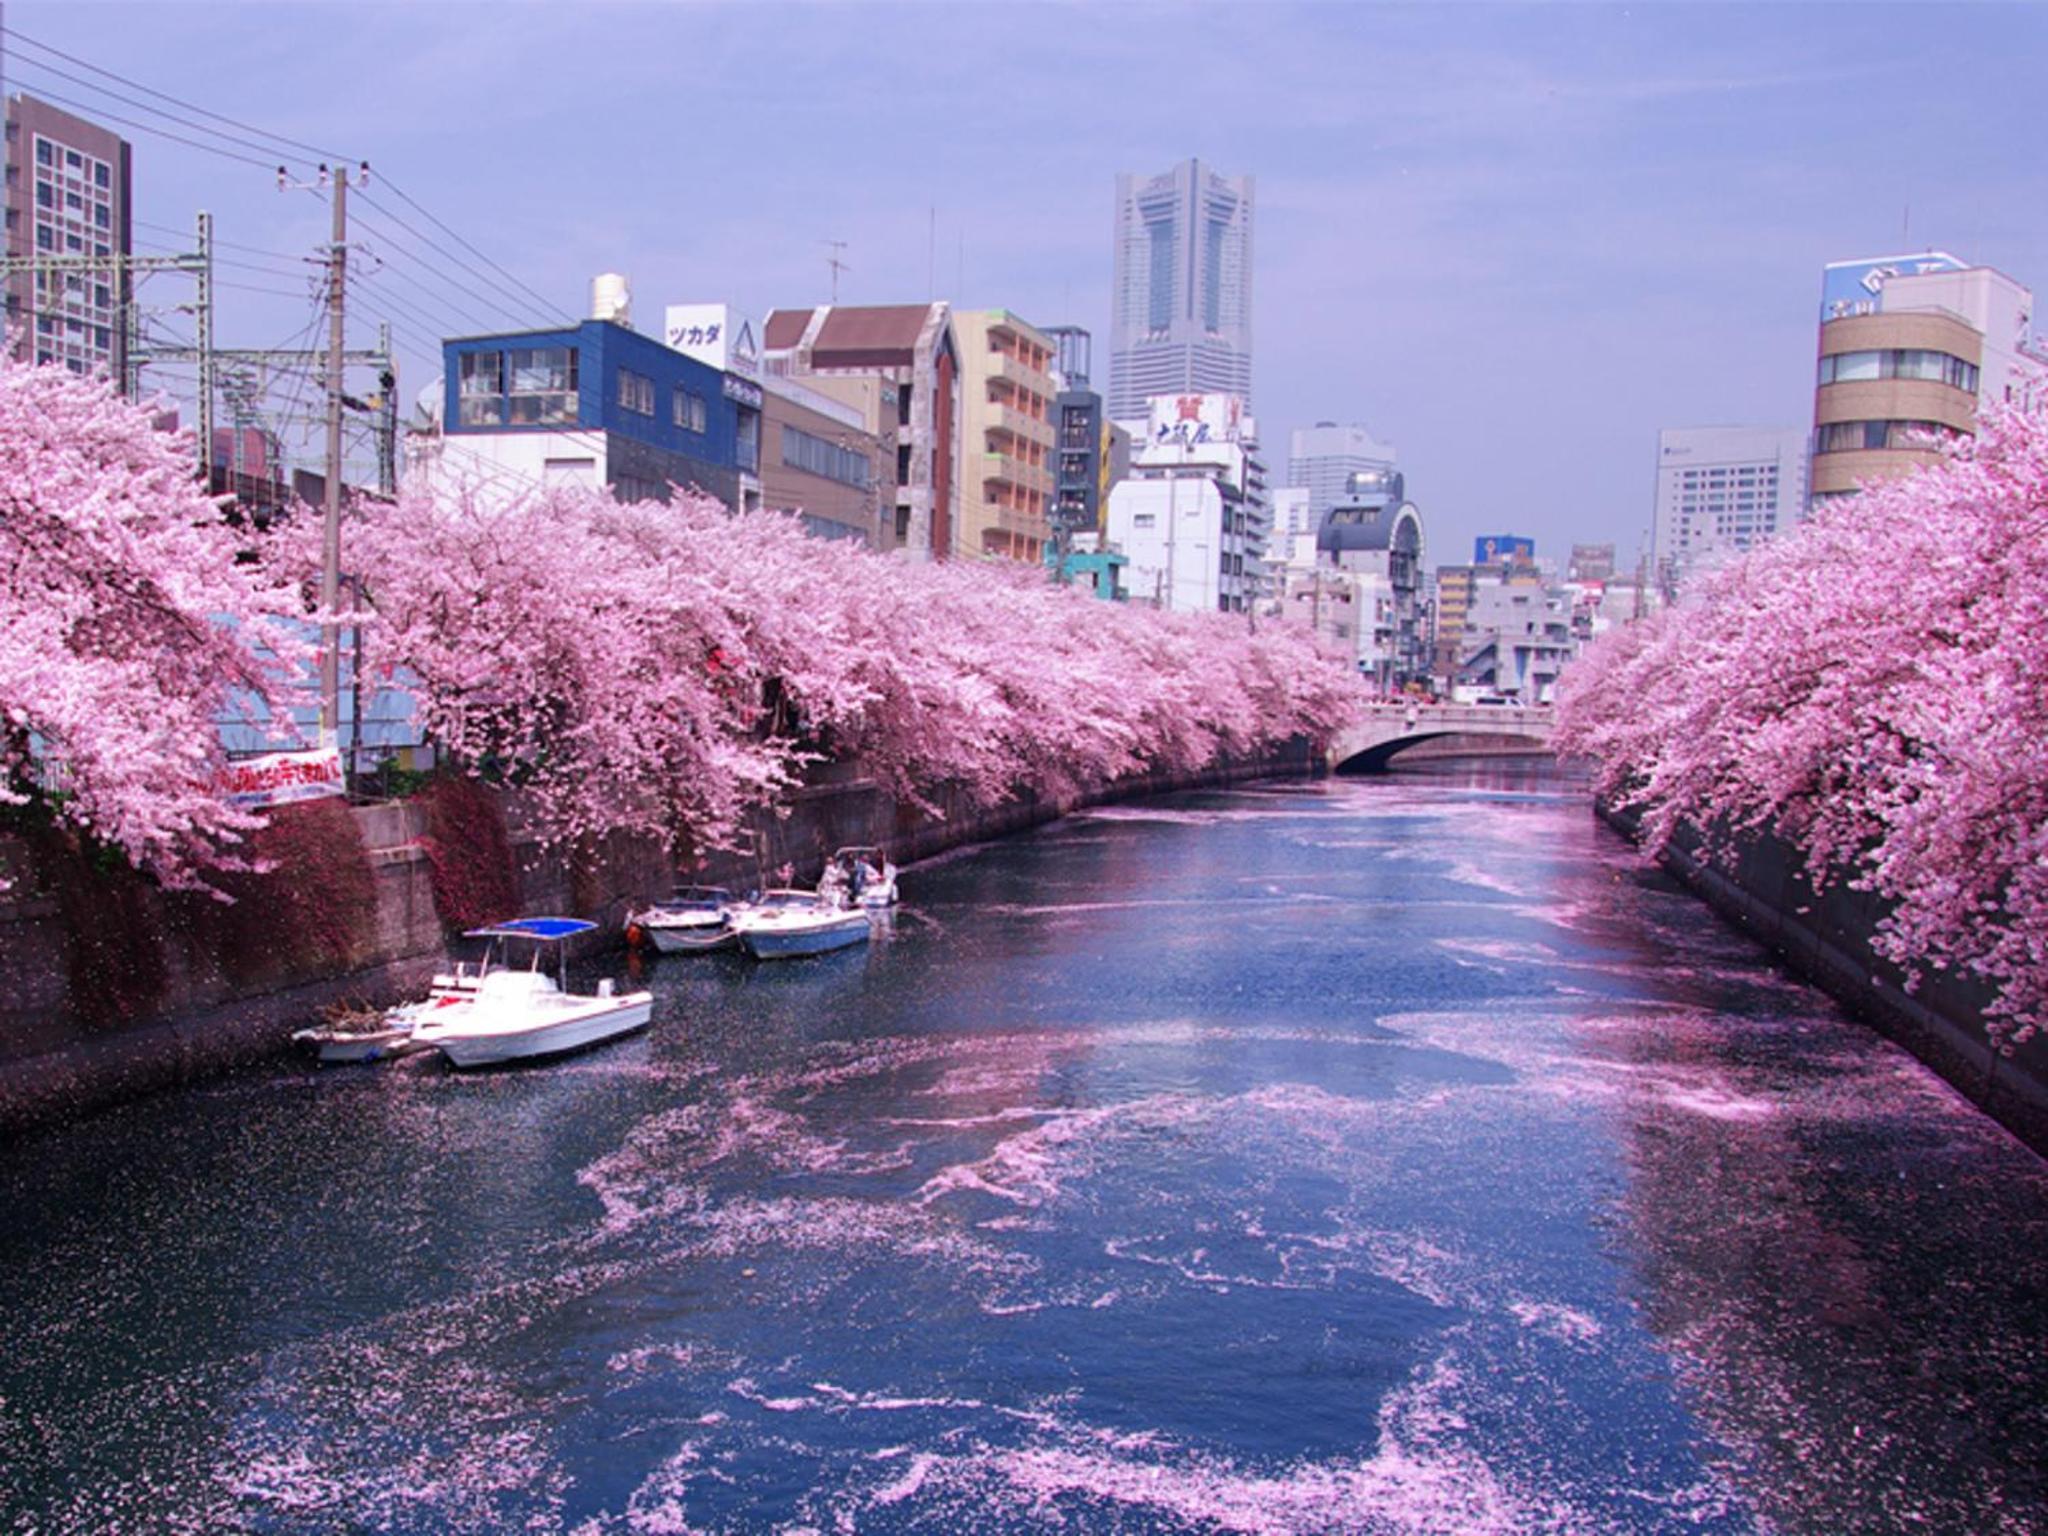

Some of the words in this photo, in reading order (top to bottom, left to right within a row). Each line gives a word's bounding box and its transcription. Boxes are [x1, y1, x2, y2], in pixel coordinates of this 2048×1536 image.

[669, 324, 721, 345] ツカダ
[1176, 397, 1203, 423] 質
